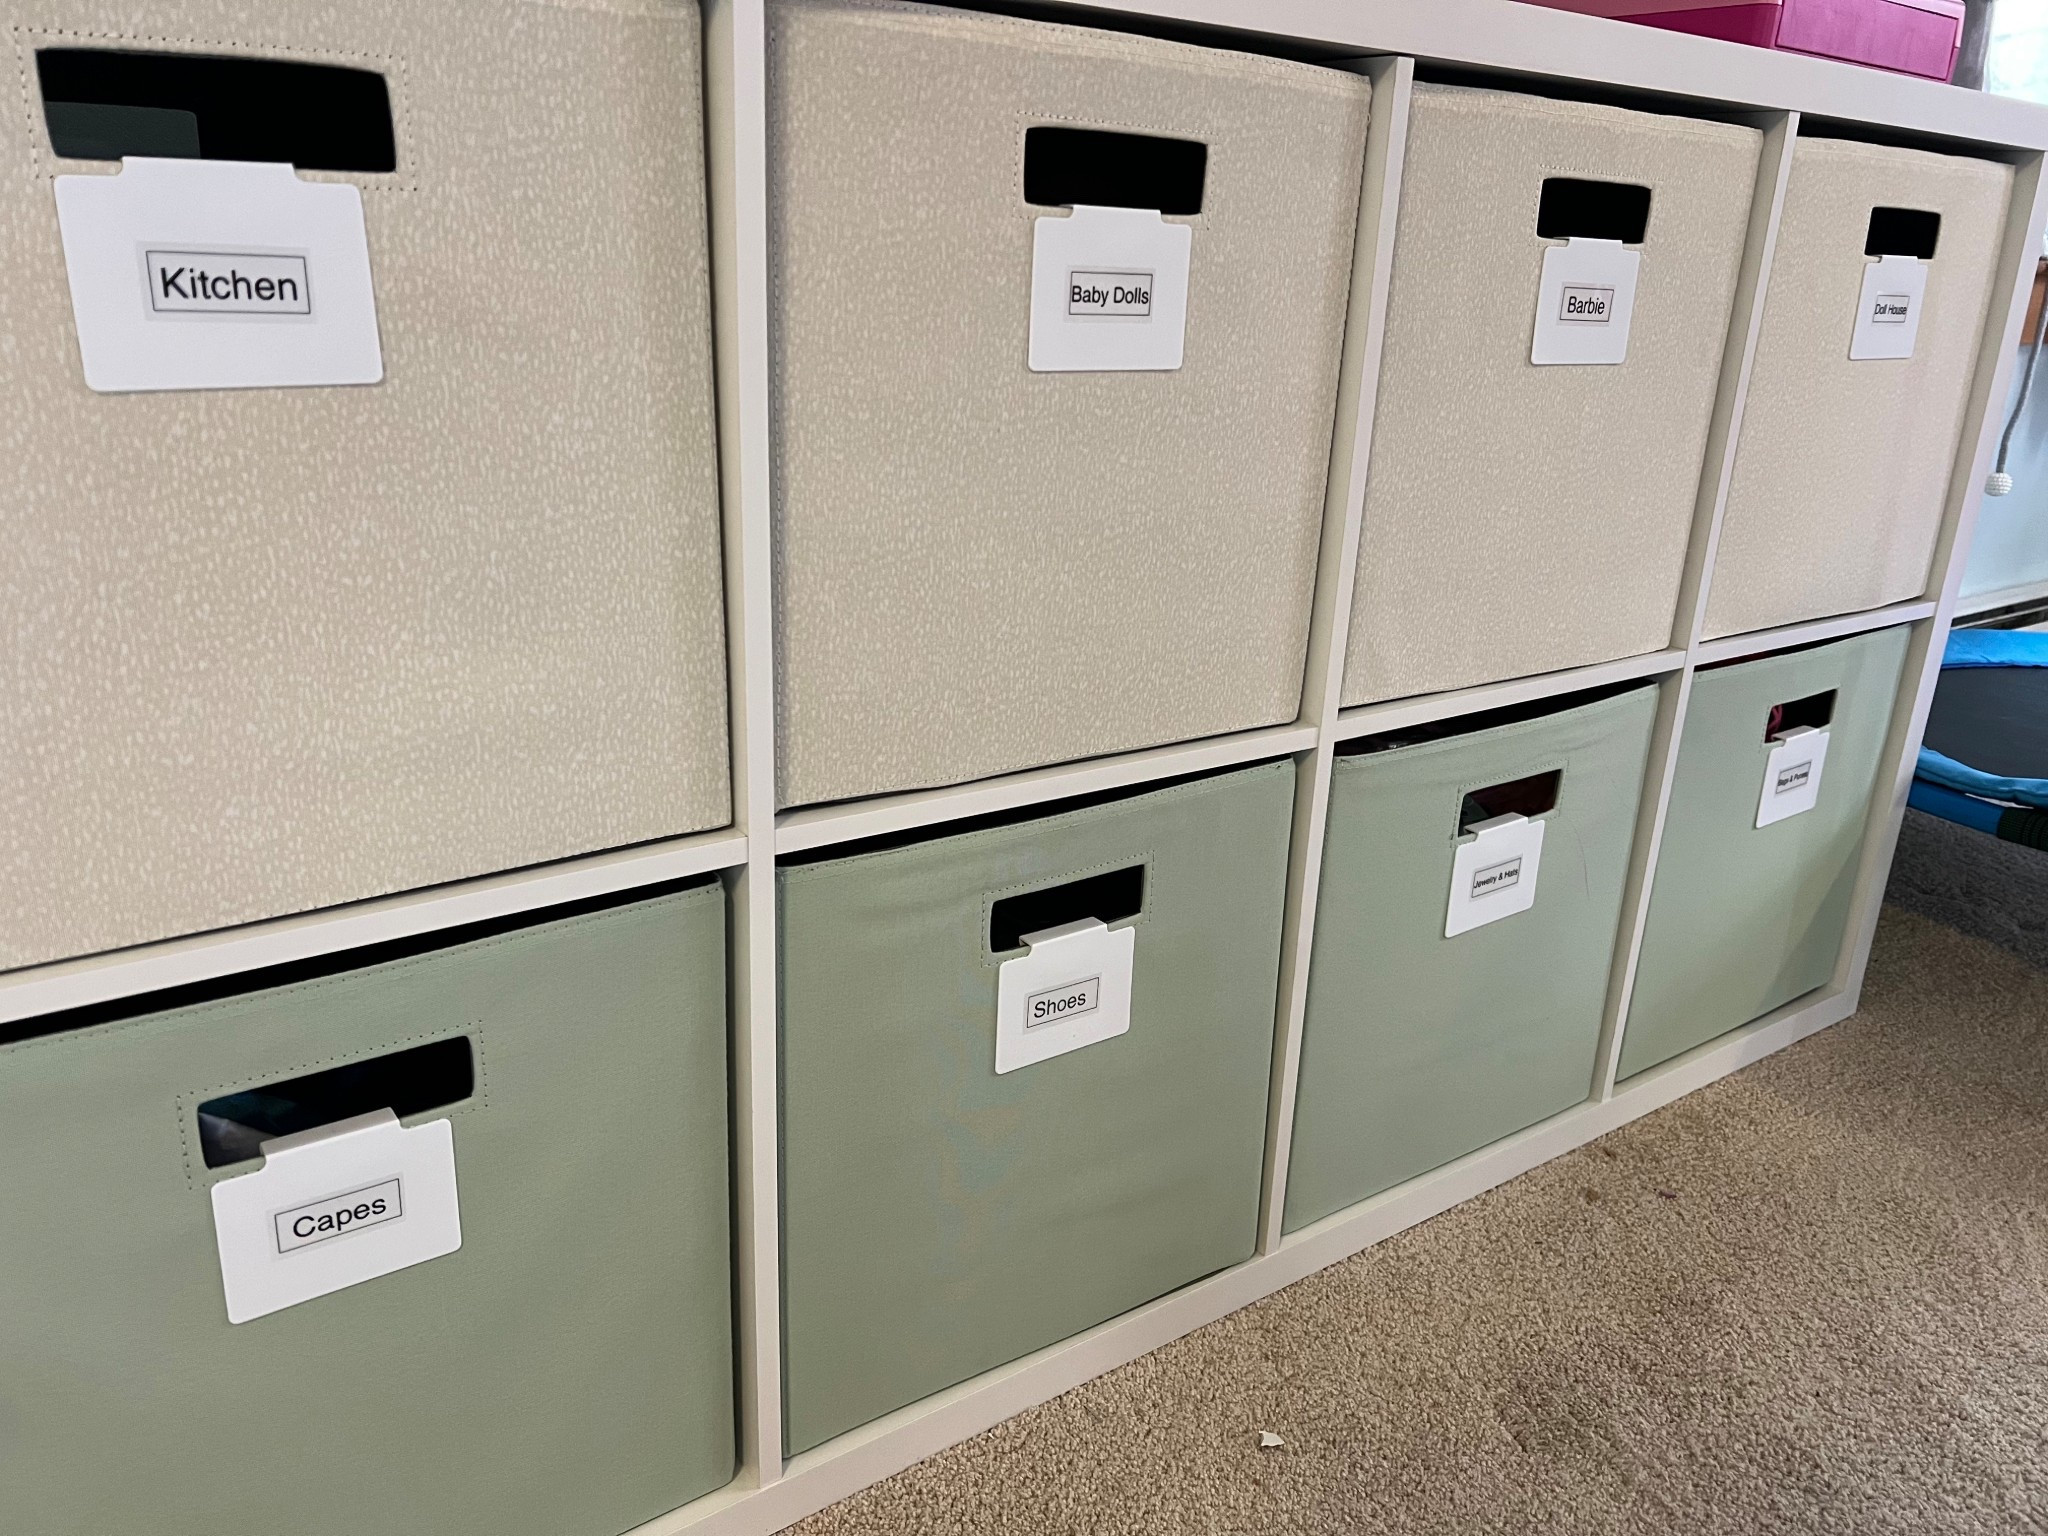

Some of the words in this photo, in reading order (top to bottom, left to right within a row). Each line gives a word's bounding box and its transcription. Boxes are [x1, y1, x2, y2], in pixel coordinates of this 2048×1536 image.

[160, 267, 298, 301] Kitchen
[1071, 285, 1109, 307] Baby
[1113, 286, 1149, 304] Dolls
[1567, 296, 1605, 314] Barbie
[1875, 303, 1888, 314] Doll
[1888, 304, 1907, 315] House
[1498, 872, 1503, 881] &
[1504, 868, 1518, 879] Hats
[1034, 993, 1086, 1018] Shoes
[293, 1198, 386, 1237] Capes
